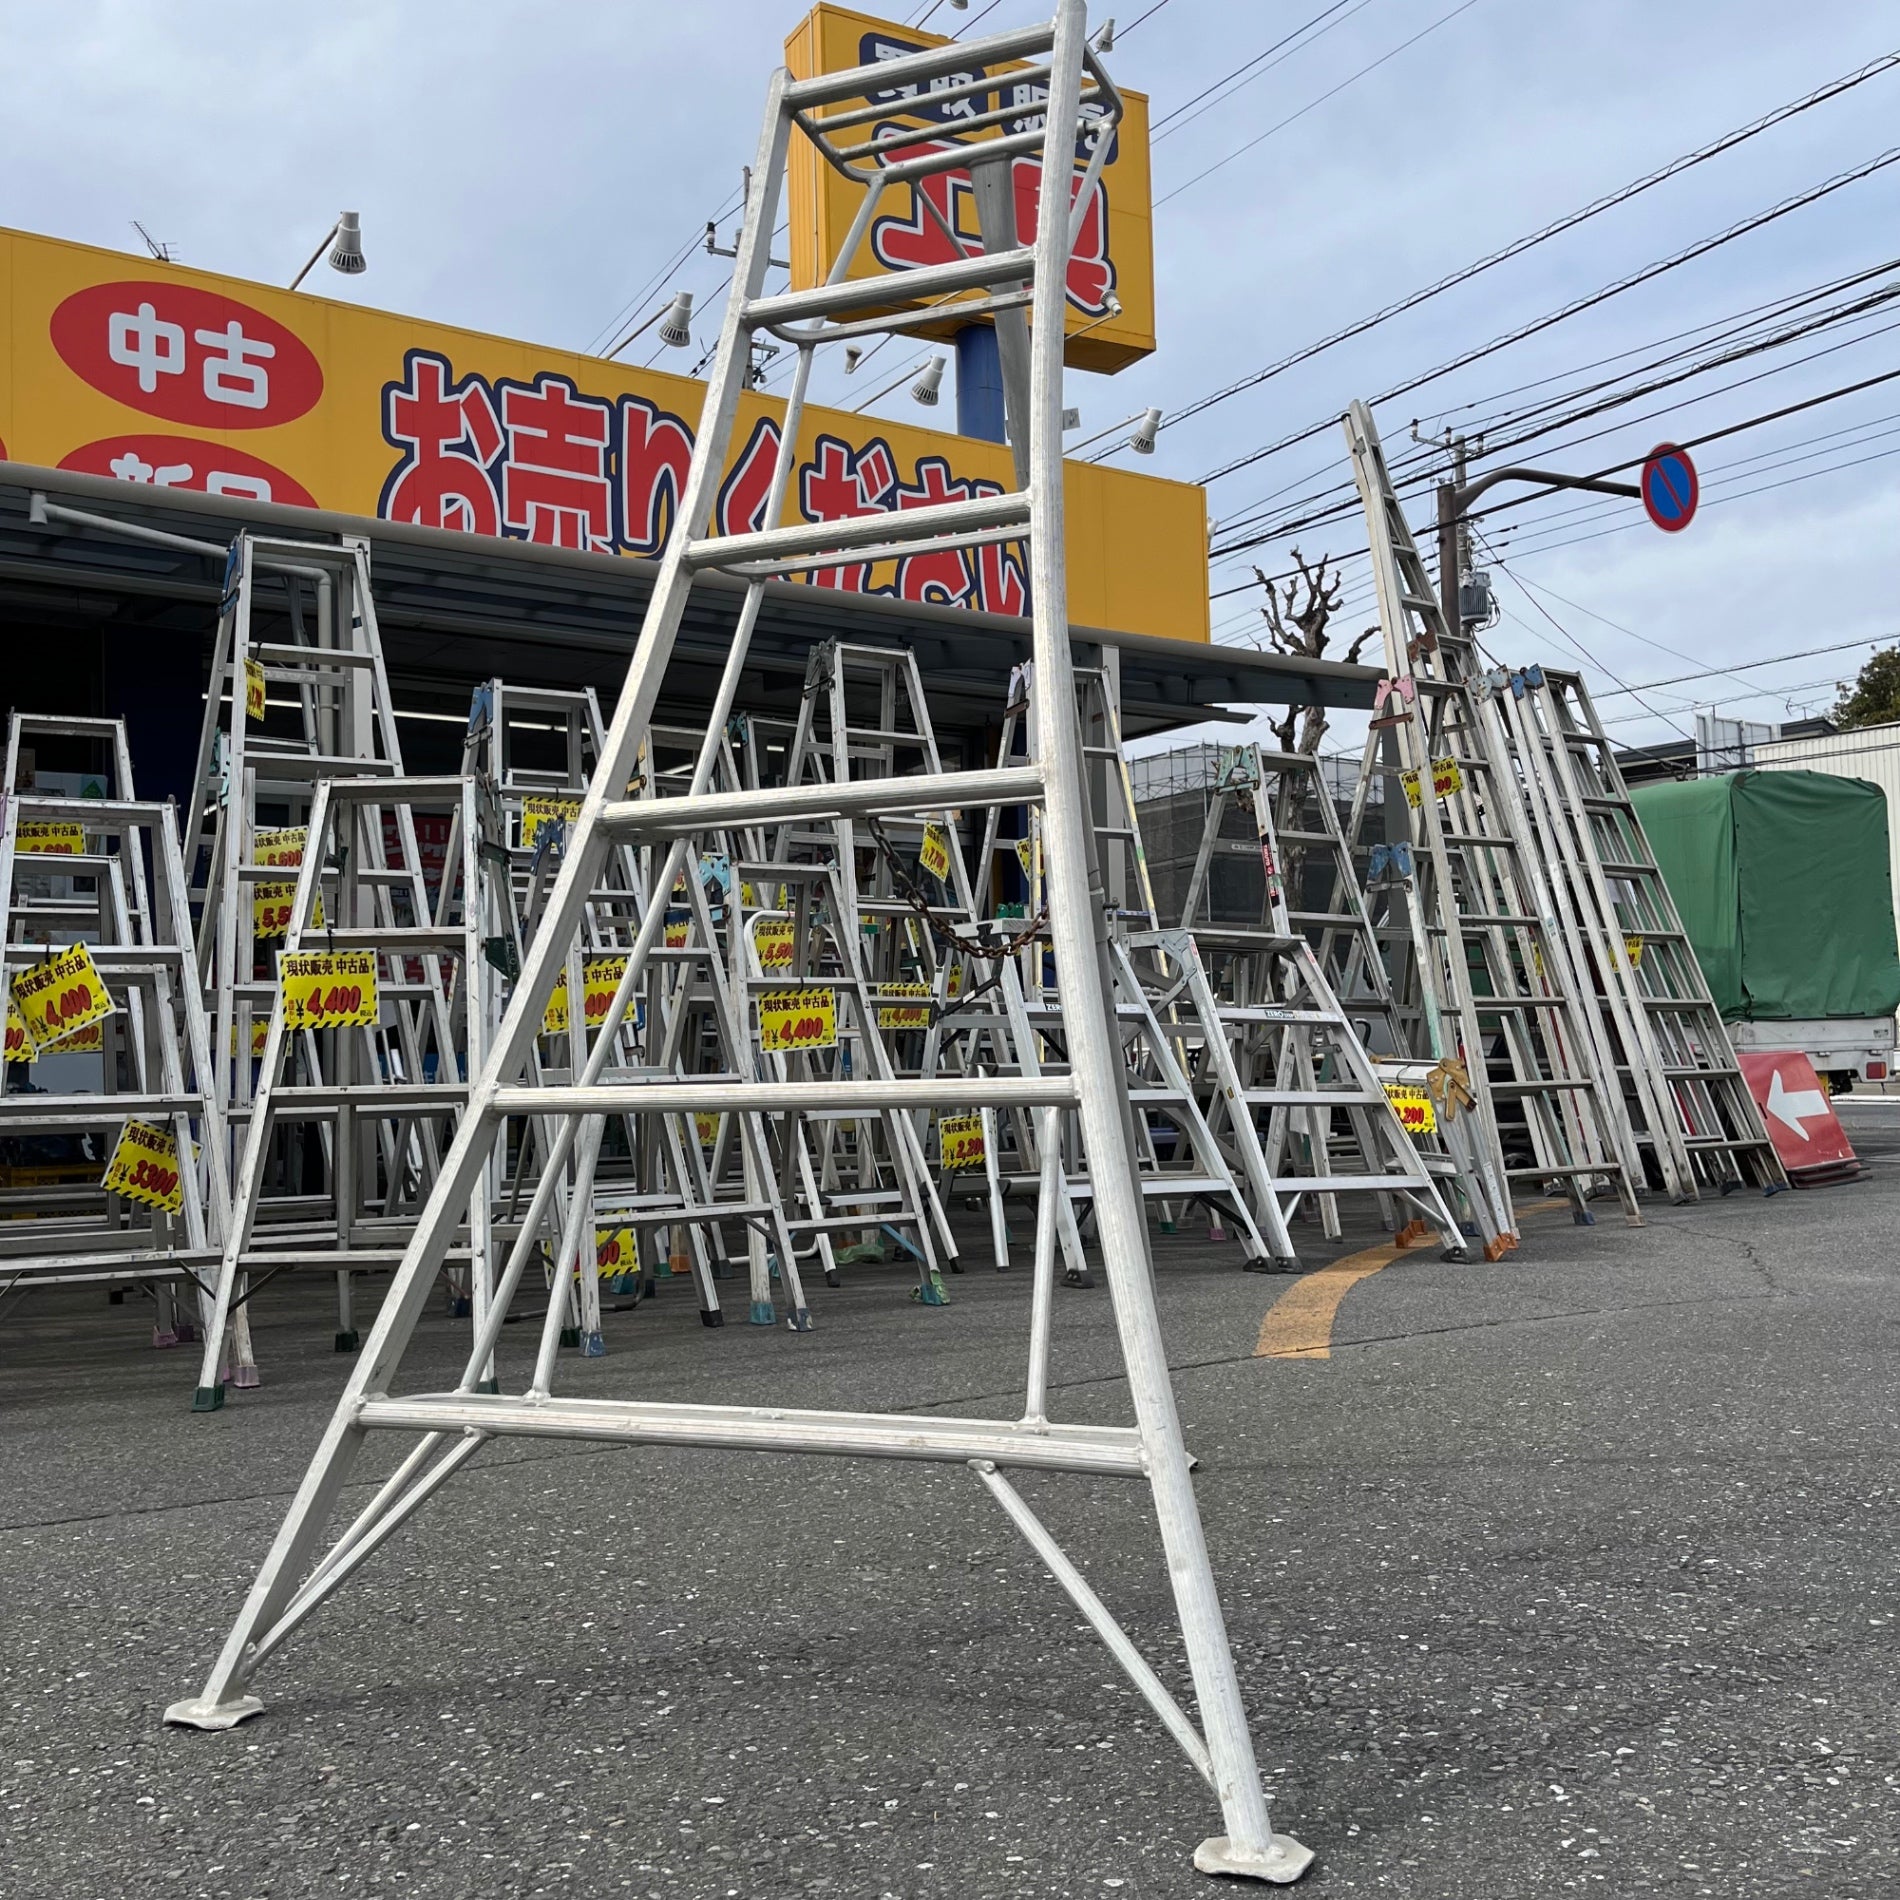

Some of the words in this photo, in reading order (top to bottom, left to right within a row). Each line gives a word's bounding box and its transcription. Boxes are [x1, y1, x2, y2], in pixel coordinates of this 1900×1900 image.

[108, 303, 276, 409] 中古
[527, 803, 559, 815] 現状販売
[562, 806, 581, 817] 中古
[52, 826, 78, 836] 中古品
[283, 832, 305, 844] 中古品
[253, 887, 283, 900] 状販売
[759, 925, 785, 936] 現状販売
[287, 958, 333, 976] 現状販売
[336, 958, 369, 974] 中古品
[592, 966, 624, 983] 中古品
[15, 970, 56, 1000] 現状販売
[55, 955, 86, 979] 中古品
[764, 998, 800, 1012] 現状販売
[803, 996, 829, 1009] 中古品
[1385, 1089, 1407, 1100] 状販売
[128, 1127, 166, 1154] 現状販売
